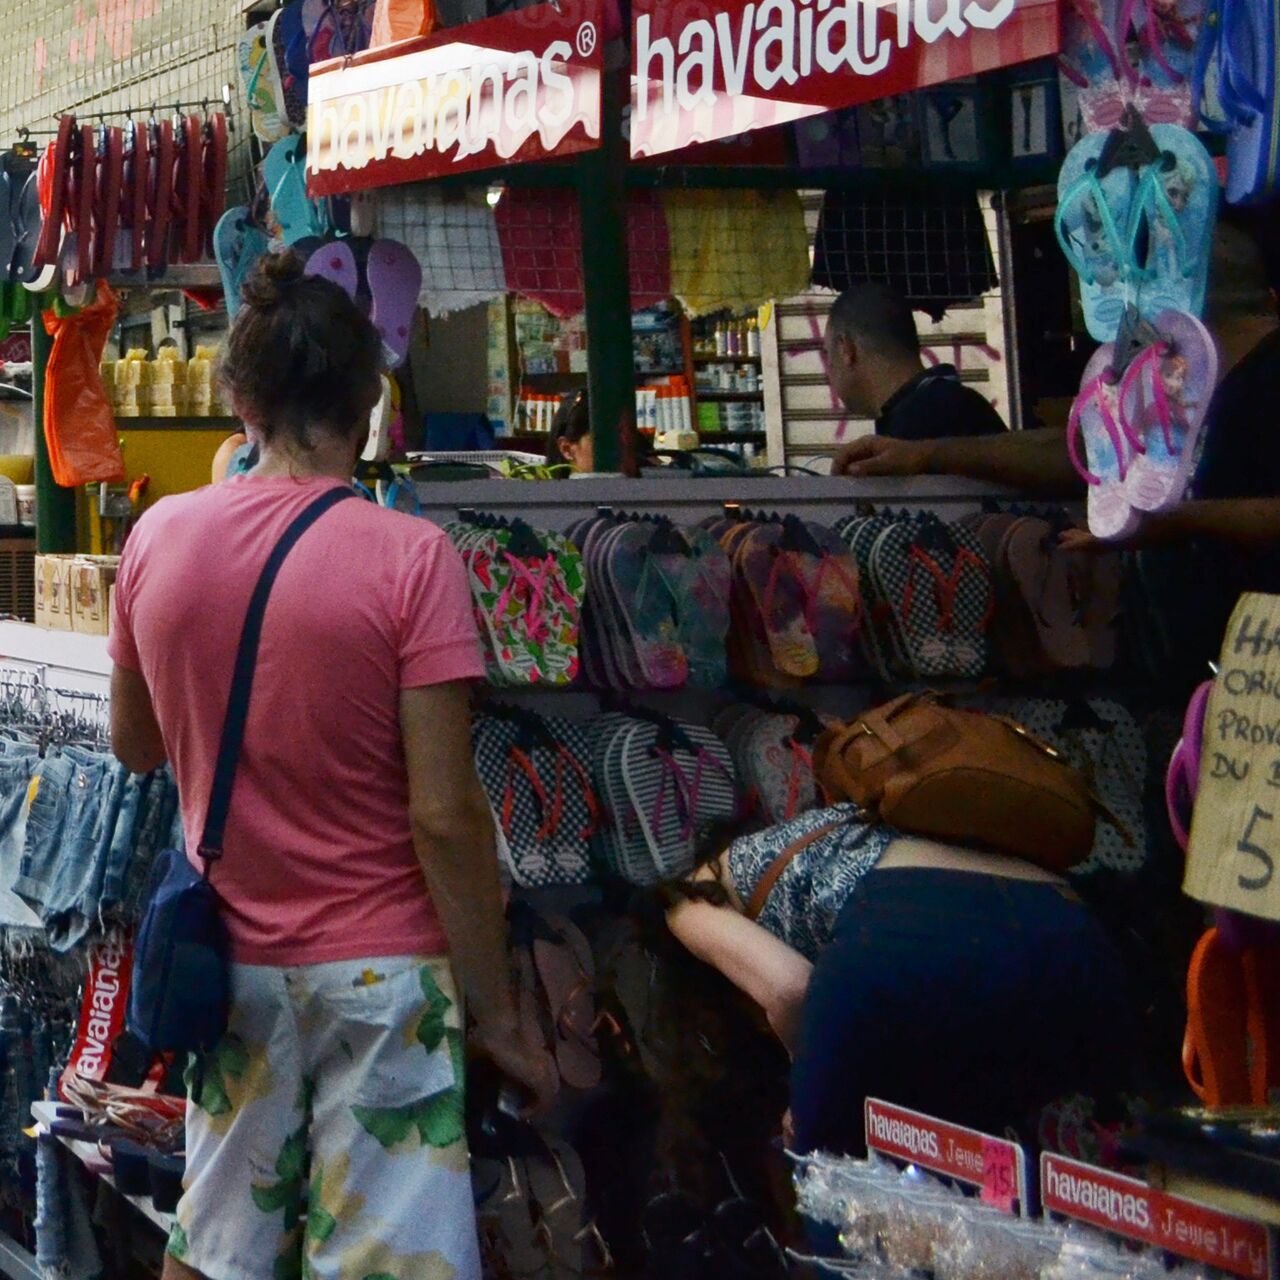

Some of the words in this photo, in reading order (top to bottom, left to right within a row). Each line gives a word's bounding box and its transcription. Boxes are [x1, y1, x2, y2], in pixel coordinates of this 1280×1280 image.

[1210, 751, 1249, 781] DU
[868, 1106, 940, 1159] havaianas
[1045, 1161, 1151, 1229] havaianas
[1161, 1207, 1264, 1277] Jewelry
